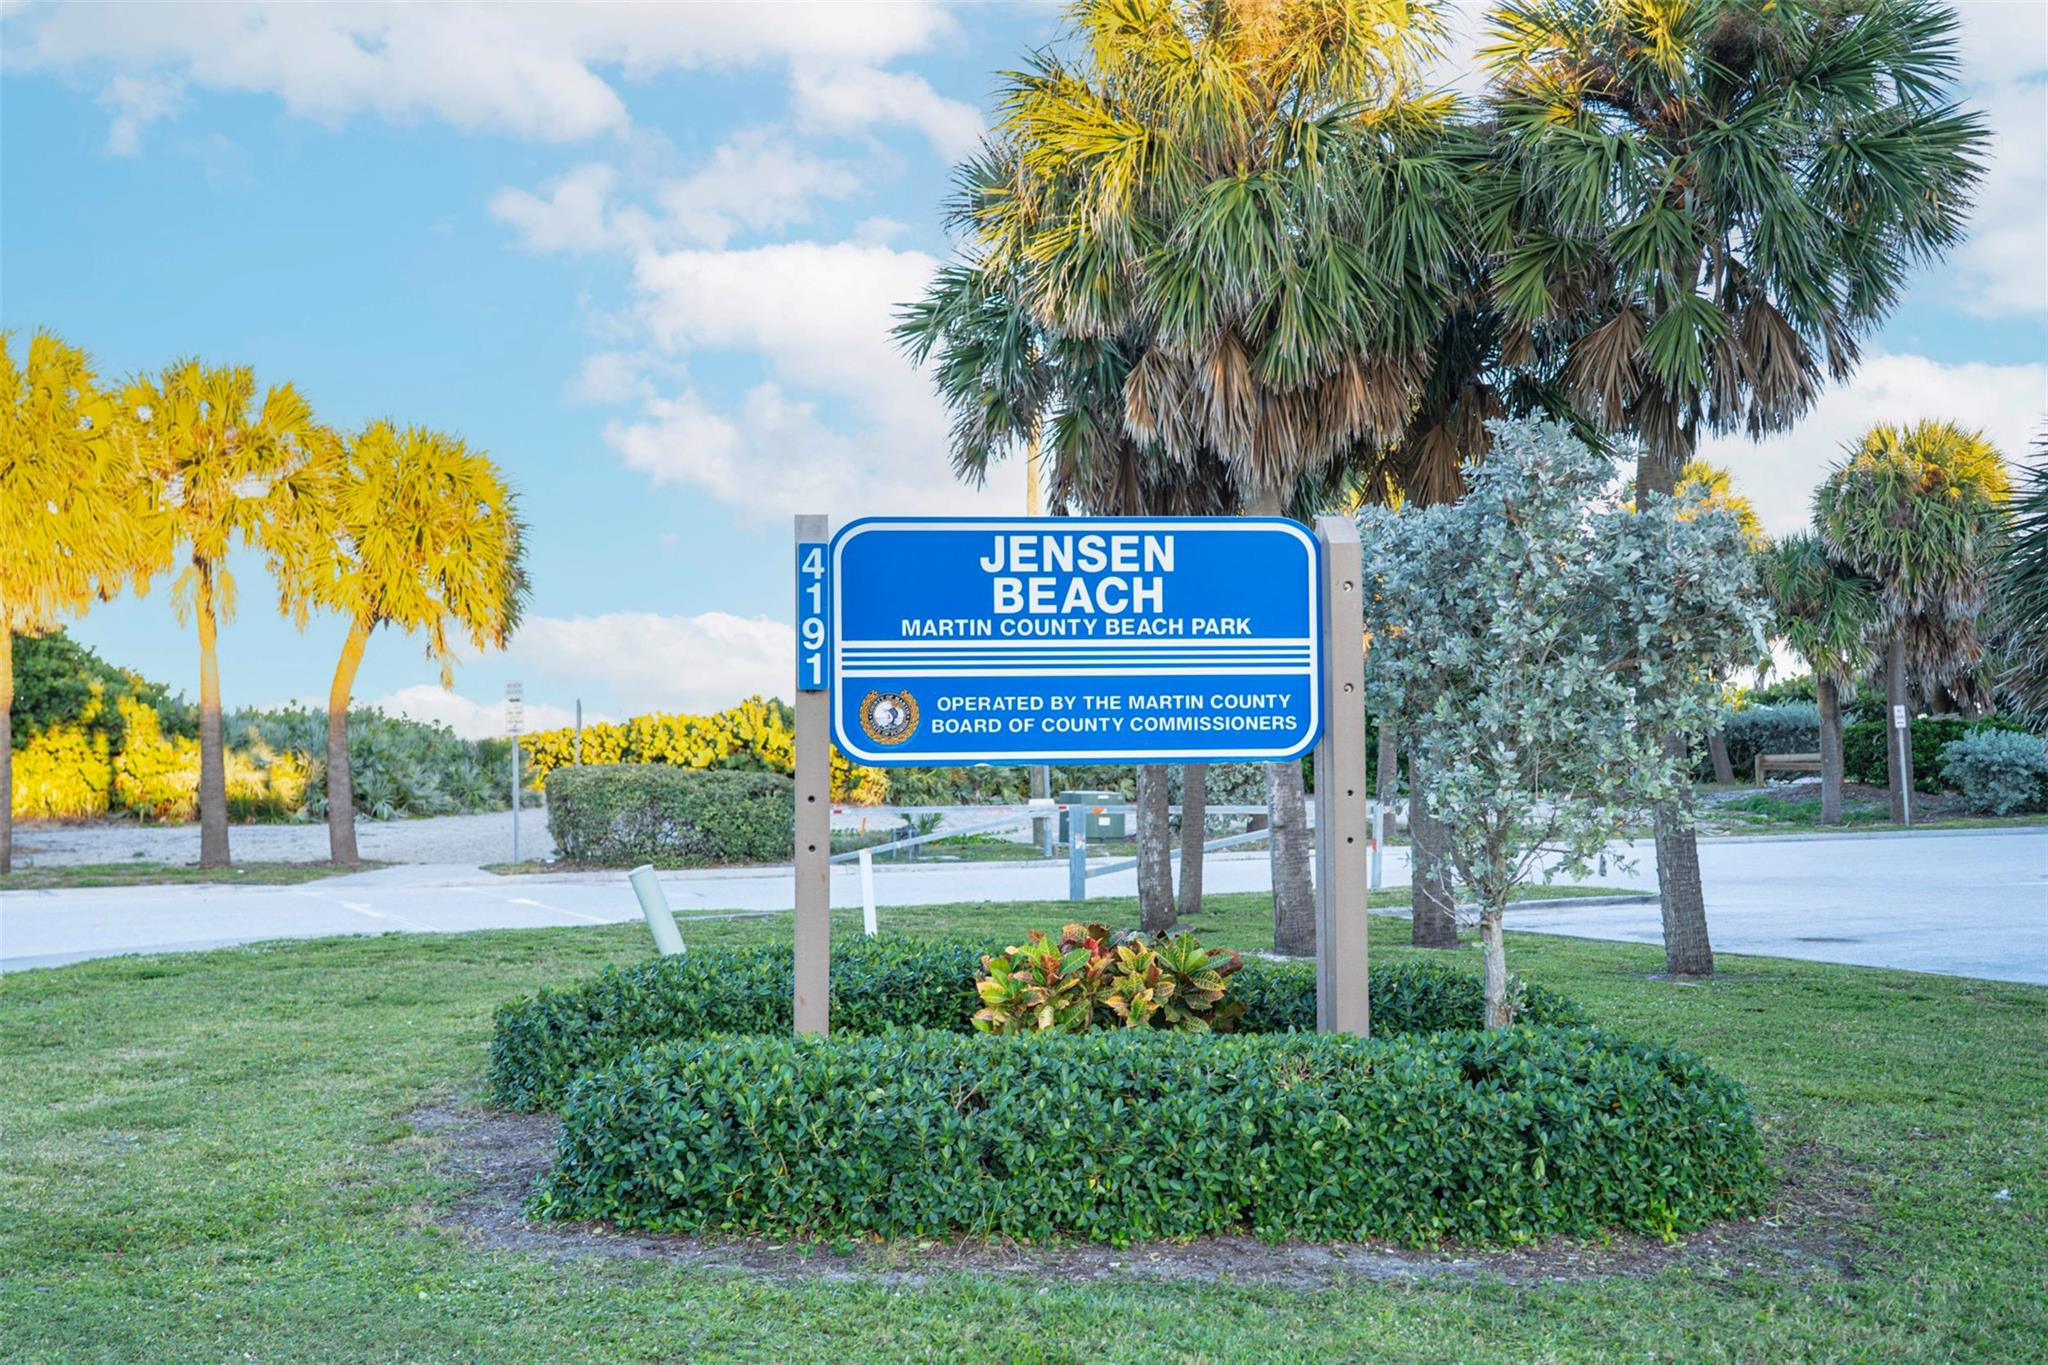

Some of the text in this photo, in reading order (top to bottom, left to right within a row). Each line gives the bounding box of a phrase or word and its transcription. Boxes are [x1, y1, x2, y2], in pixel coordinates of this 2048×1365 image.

[980, 535, 1175, 572] JENSEN
[993, 577, 1164, 614] BEACH
[801, 547, 825, 684] 4191
[901, 617, 1252, 637] MARTIN COUNTY BEACH PARK
[937, 694, 1291, 712] OPERATED BY THE MARTIN COUNTY
[931, 715, 1298, 734] BOARD OF COUNTY COMMISSIONERS
